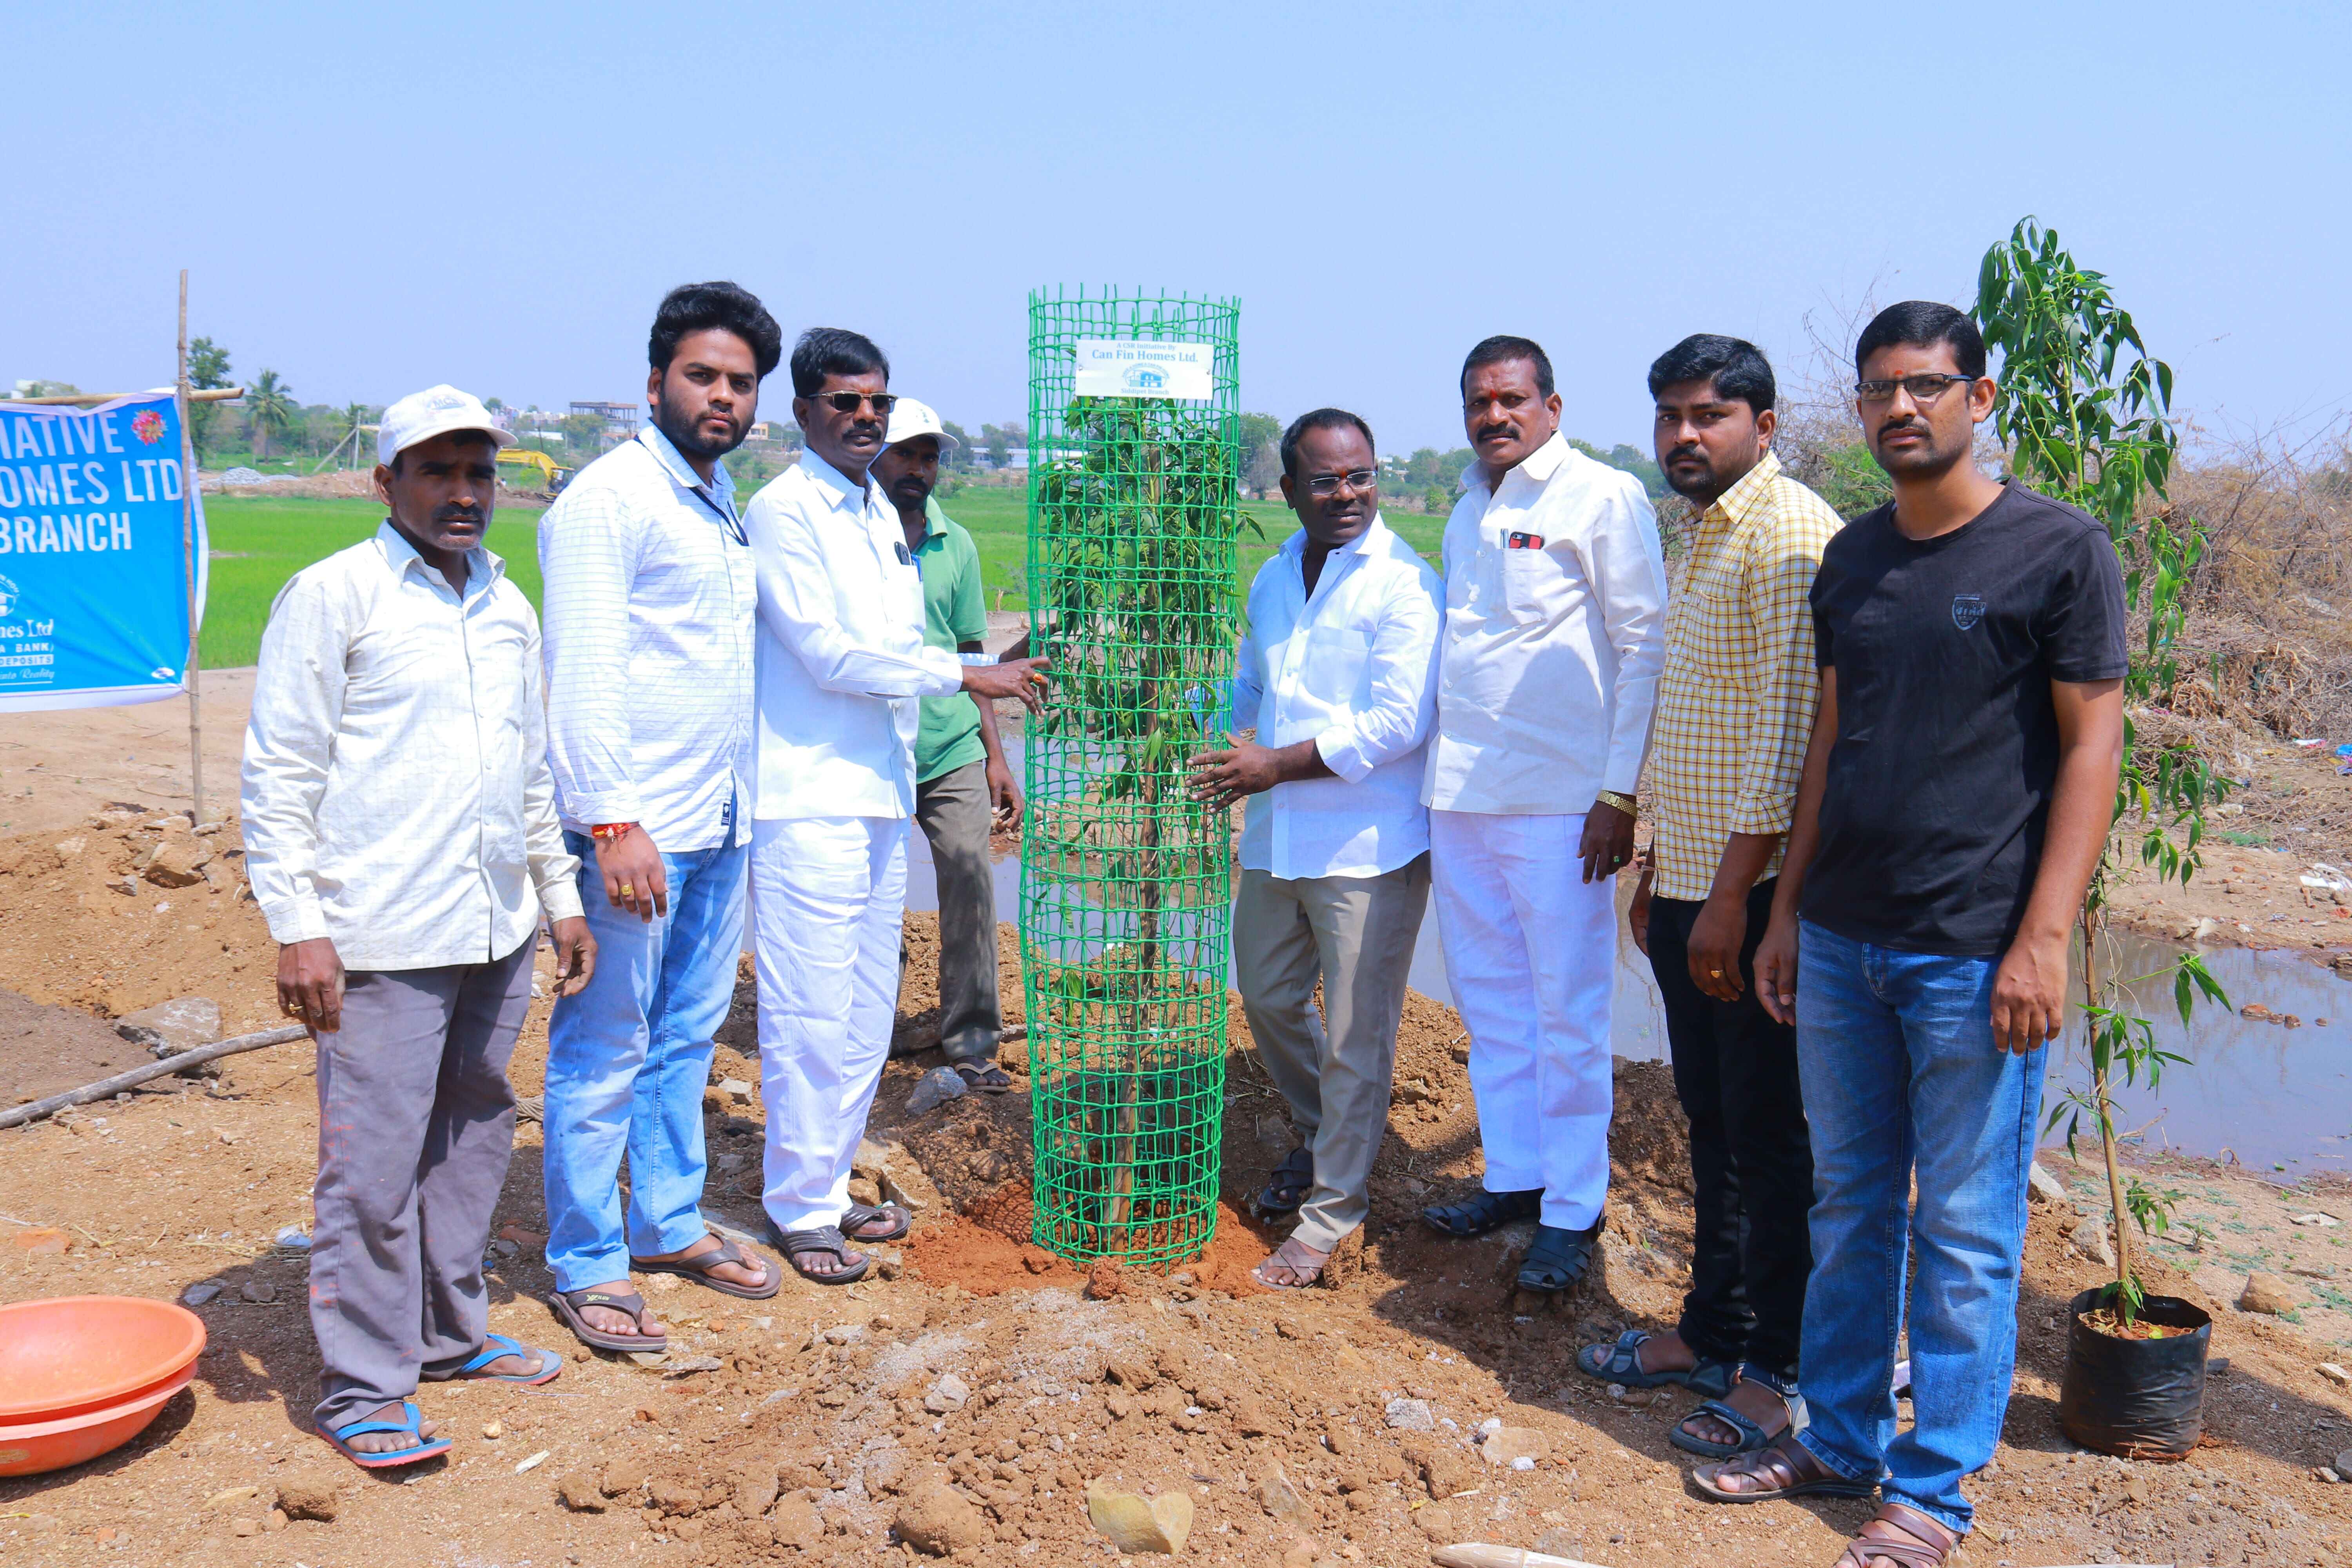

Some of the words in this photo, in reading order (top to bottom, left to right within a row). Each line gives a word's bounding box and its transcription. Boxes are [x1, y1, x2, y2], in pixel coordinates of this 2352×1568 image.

[1092, 349, 1112, 359] Can
[1116, 350, 1134, 359] Fin
[1138, 350, 1176, 361] Homes
[1179, 352, 1198, 362] Ltd.
[0, 461, 110, 508] OMES
[121, 459, 183, 502] LTD
[0, 512, 131, 554] BRANCH
[26, 619, 54, 637] Ltd
